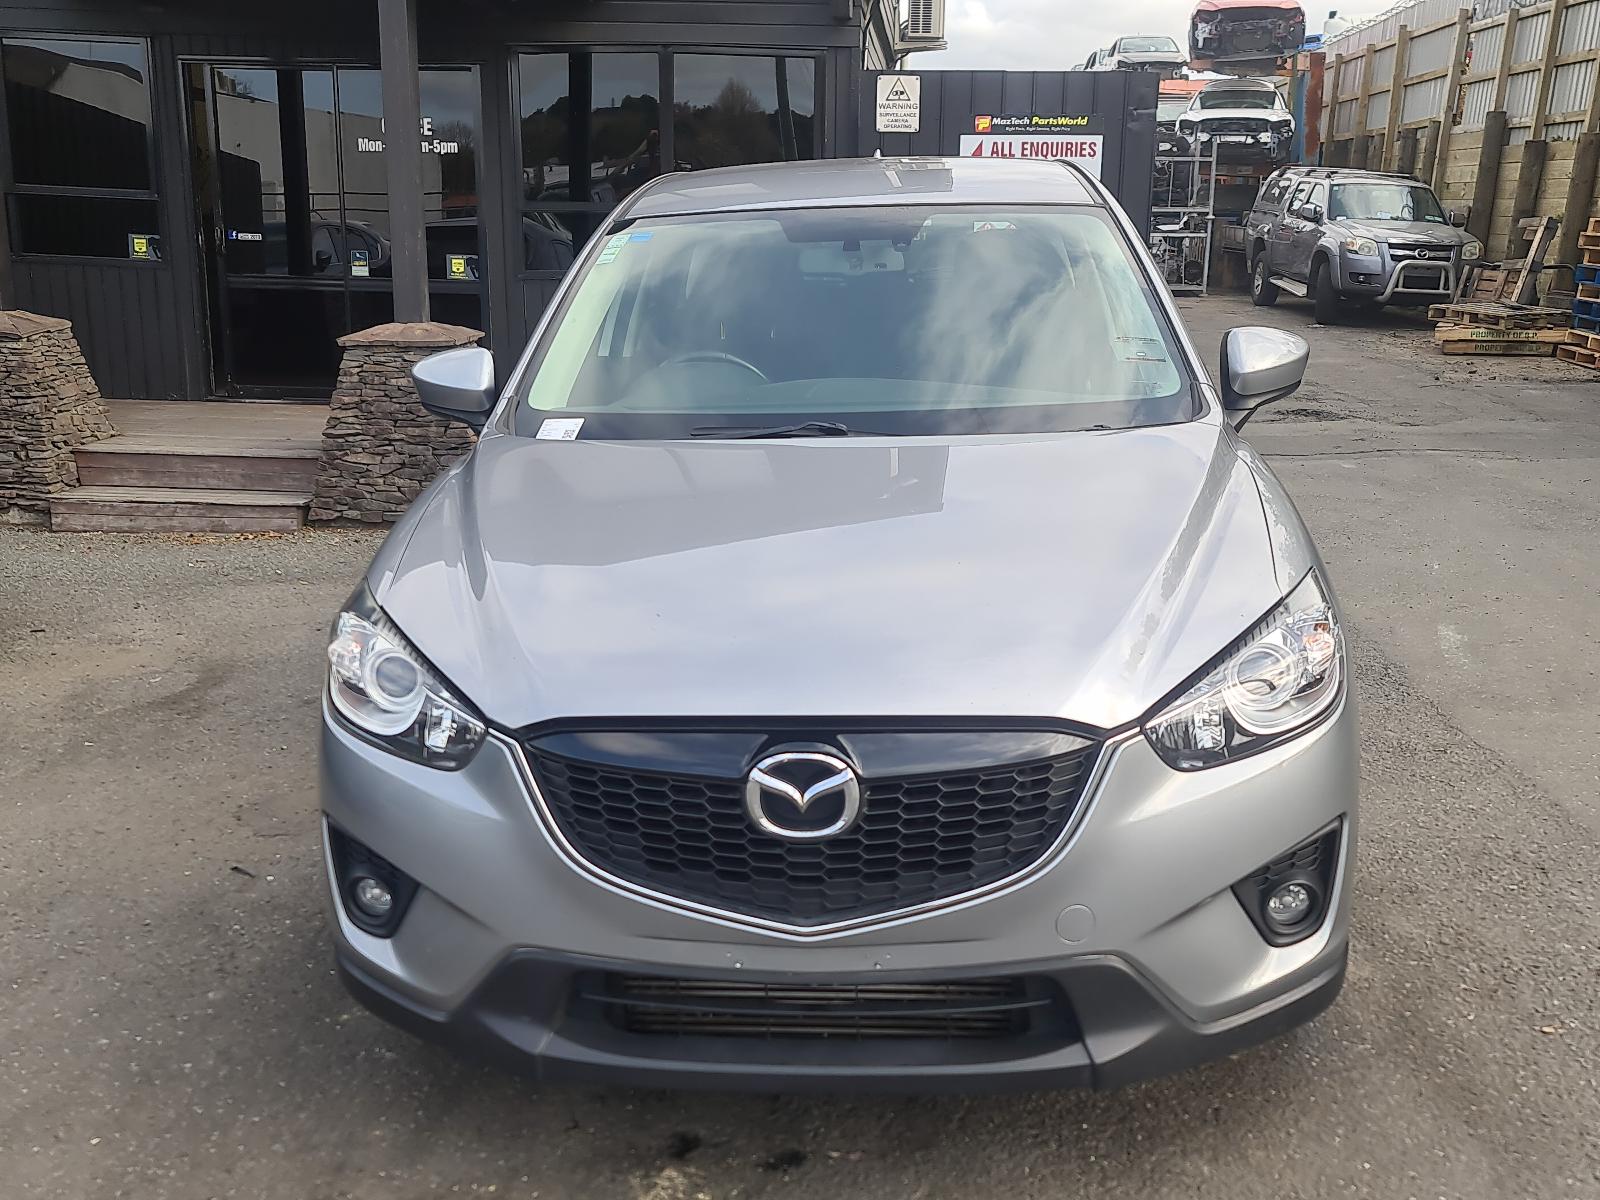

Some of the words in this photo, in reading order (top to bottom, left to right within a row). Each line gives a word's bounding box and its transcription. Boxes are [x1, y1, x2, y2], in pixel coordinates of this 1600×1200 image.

[878, 102, 918, 110] WARNING
[992, 117, 1030, 125] MazTech
[1031, 116, 1088, 125] PartsWorld
[357, 138, 386, 152] Mon-
[990, 141, 1015, 158] ALL
[1021, 141, 1097, 159] ENQUIRIES
